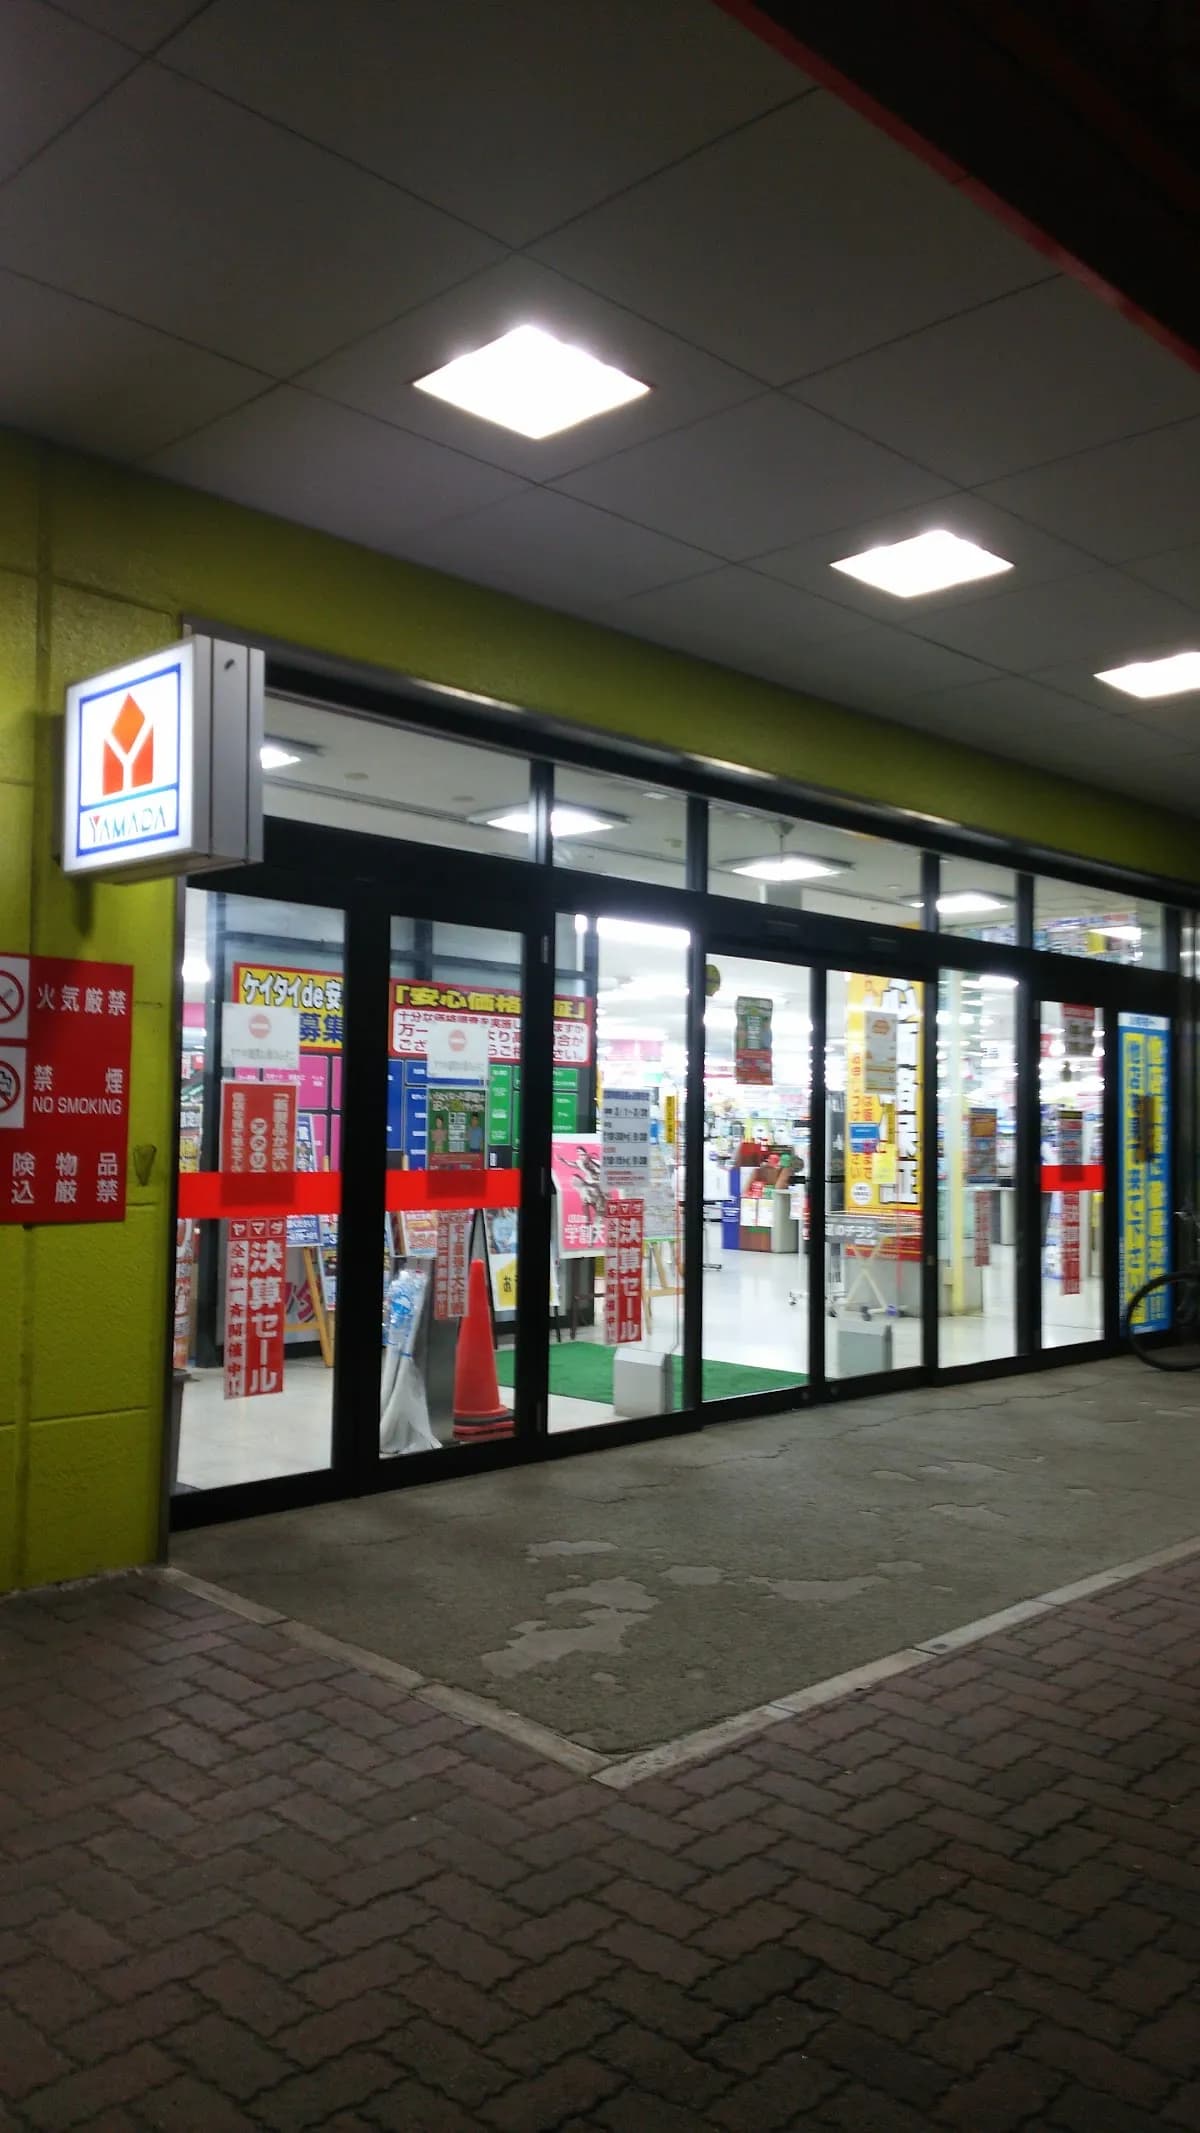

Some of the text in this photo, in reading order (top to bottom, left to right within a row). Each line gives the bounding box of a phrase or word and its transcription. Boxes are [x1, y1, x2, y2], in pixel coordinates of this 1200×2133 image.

[89, 805, 167, 843] YAMADA
[37, 984, 127, 1016] 火気厳禁
[32, 1096, 122, 1115] NO SMOKING
[231, 1221, 284, 1237] ヤマダ
[619, 1217, 641, 1341] 決算セール
[249, 1239, 284, 1393] 決算セール
